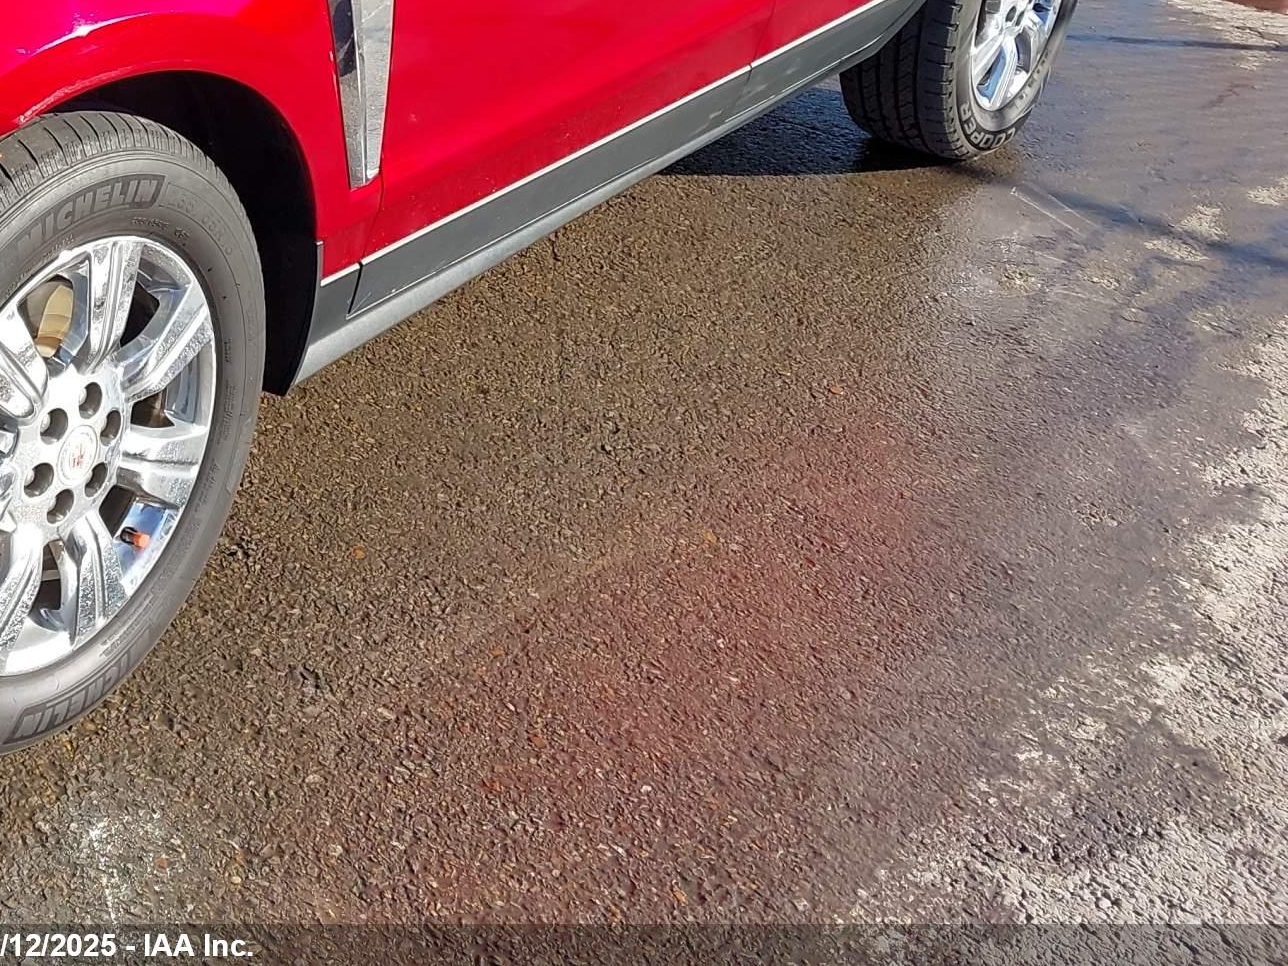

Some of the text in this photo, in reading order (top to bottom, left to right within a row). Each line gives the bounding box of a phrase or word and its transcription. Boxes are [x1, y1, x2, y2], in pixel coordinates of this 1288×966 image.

[960, 100, 1016, 149] COOPER
[16, 179, 159, 251] MICHELIN
[13, 628, 151, 736] MICHELIN
